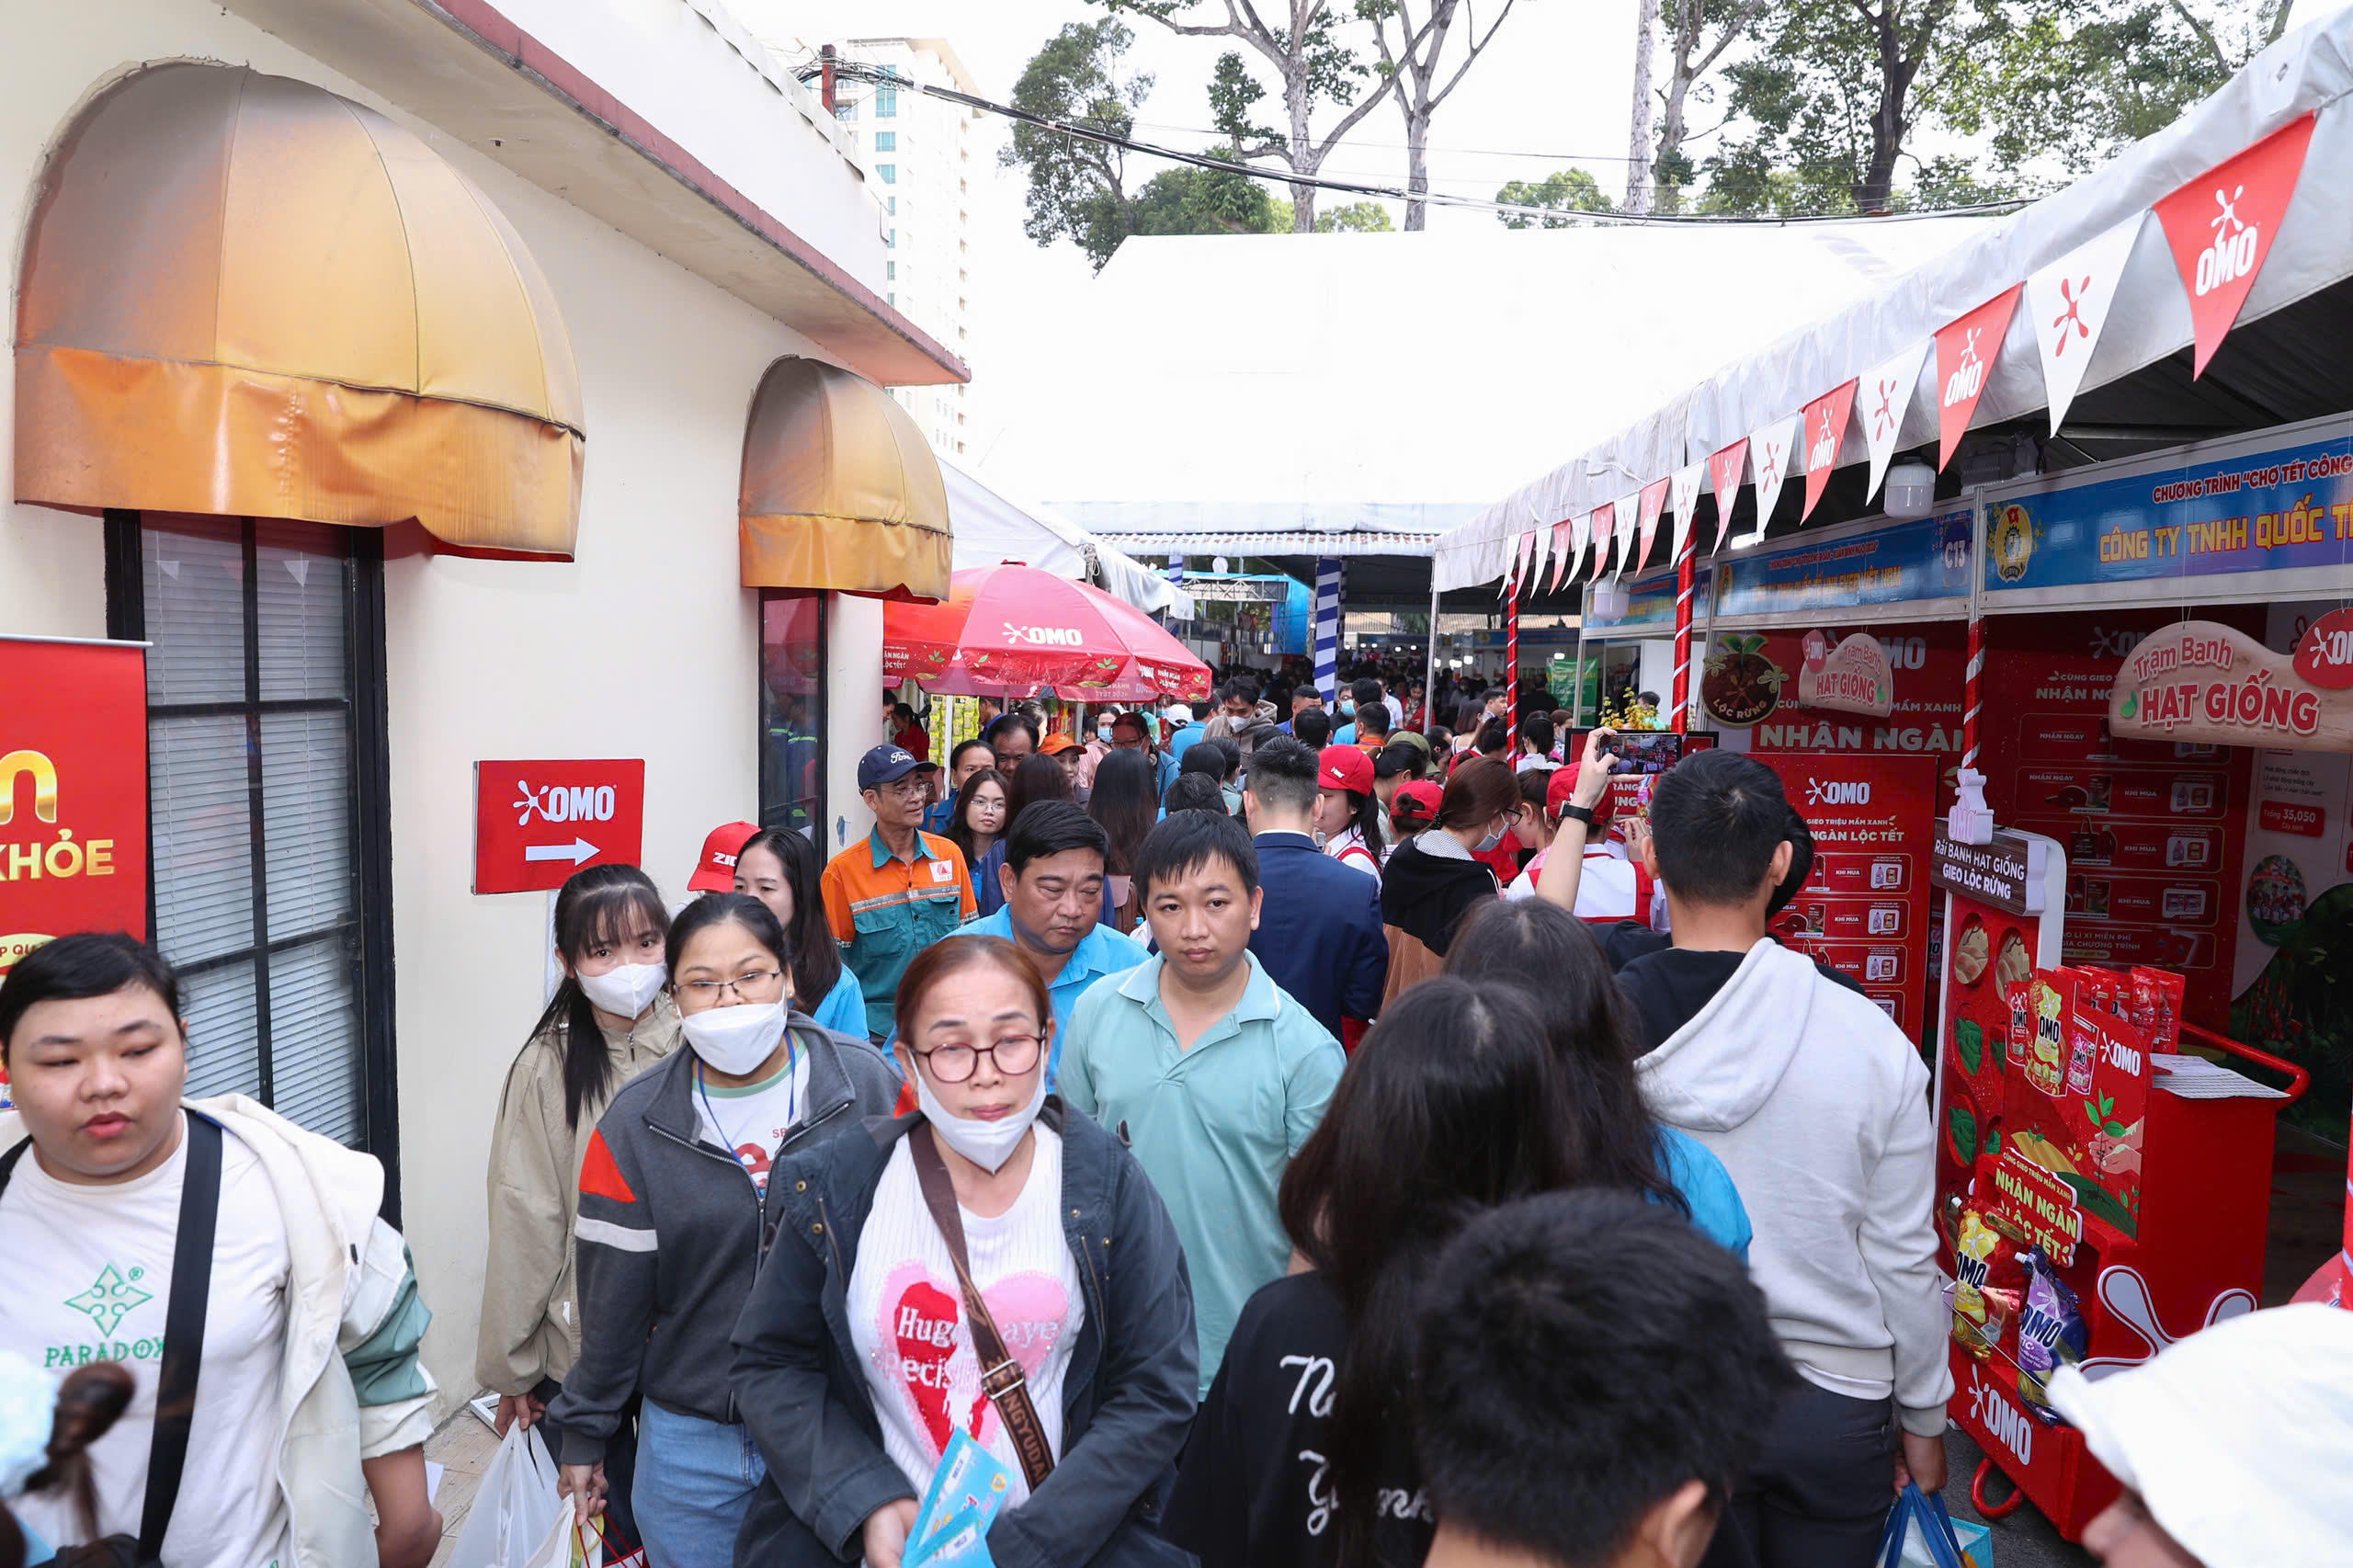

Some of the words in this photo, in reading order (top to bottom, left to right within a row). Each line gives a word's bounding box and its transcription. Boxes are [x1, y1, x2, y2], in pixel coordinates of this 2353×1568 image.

[2195, 226, 2257, 296] OMO
[1944, 360, 1984, 407] OMO
[1809, 436, 1836, 472] OMO
[2153, 481, 2203, 504] CHƯƠNG
[2205, 471, 2241, 496] TRÌNH
[2280, 456, 2306, 483] TẾT
[2099, 526, 2149, 563] CÔNG
[2155, 527, 2182, 558] TY
[2187, 517, 2248, 553] TNHH
[2255, 493, 2324, 552] QUỐC
[1944, 540, 1966, 569] C13
[1029, 627, 1083, 646] OMO
[1843, 644, 1863, 665] Trạm
[1863, 645, 1881, 676] Banh
[2132, 645, 2177, 683] Trạm
[2181, 636, 2234, 670] Banh
[1815, 673, 1838, 704] HẠT
[1840, 664, 1876, 706] GIỐNG
[2036, 686, 2087, 704] NHẬN
[2140, 683, 2199, 732] HẠT
[2204, 668, 2321, 735] GIỐNG
[1712, 699, 1733, 718] LỘC
[1735, 699, 1768, 720] RỪNG
[1924, 702, 1962, 713] XANH
[1759, 720, 1862, 754] NHẬN
[549, 785, 615, 823] OMO
[1827, 781, 1870, 805] OMO
[2139, 790, 2157, 798] MUA
[1825, 817, 1847, 826] TRIỆU
[1948, 805, 1976, 846] OMO
[2282, 809, 2317, 824] 35,050
[1850, 829, 1878, 845] LỘC
[1880, 827, 1905, 842] TẾT
[1934, 838, 1948, 856] Rải
[1948, 844, 1972, 865] BANH
[1973, 851, 1992, 872] HẠT
[1993, 854, 2025, 881] GIỐNG
[1942, 862, 1963, 883] GIEO
[1963, 868, 1983, 891] LỘC
[1983, 874, 2011, 900] RỪNG
[2012, 1010, 2028, 1027] OMO
[2039, 1016, 2060, 1043] OMO
[2073, 1049, 2086, 1066] OMO
[2113, 1043, 2142, 1077] OMO
[2003, 1152, 2017, 1167] CÙNG
[2017, 1160, 2029, 1174] GIEO
[2029, 1167, 2043, 1183] TRIỆU
[1995, 1167, 2034, 1209] NHẬN
[2036, 1195, 2077, 1239] NGÀN
[2034, 1227, 2062, 1261] TẾT
[1987, 1389, 2032, 1466] OMO
